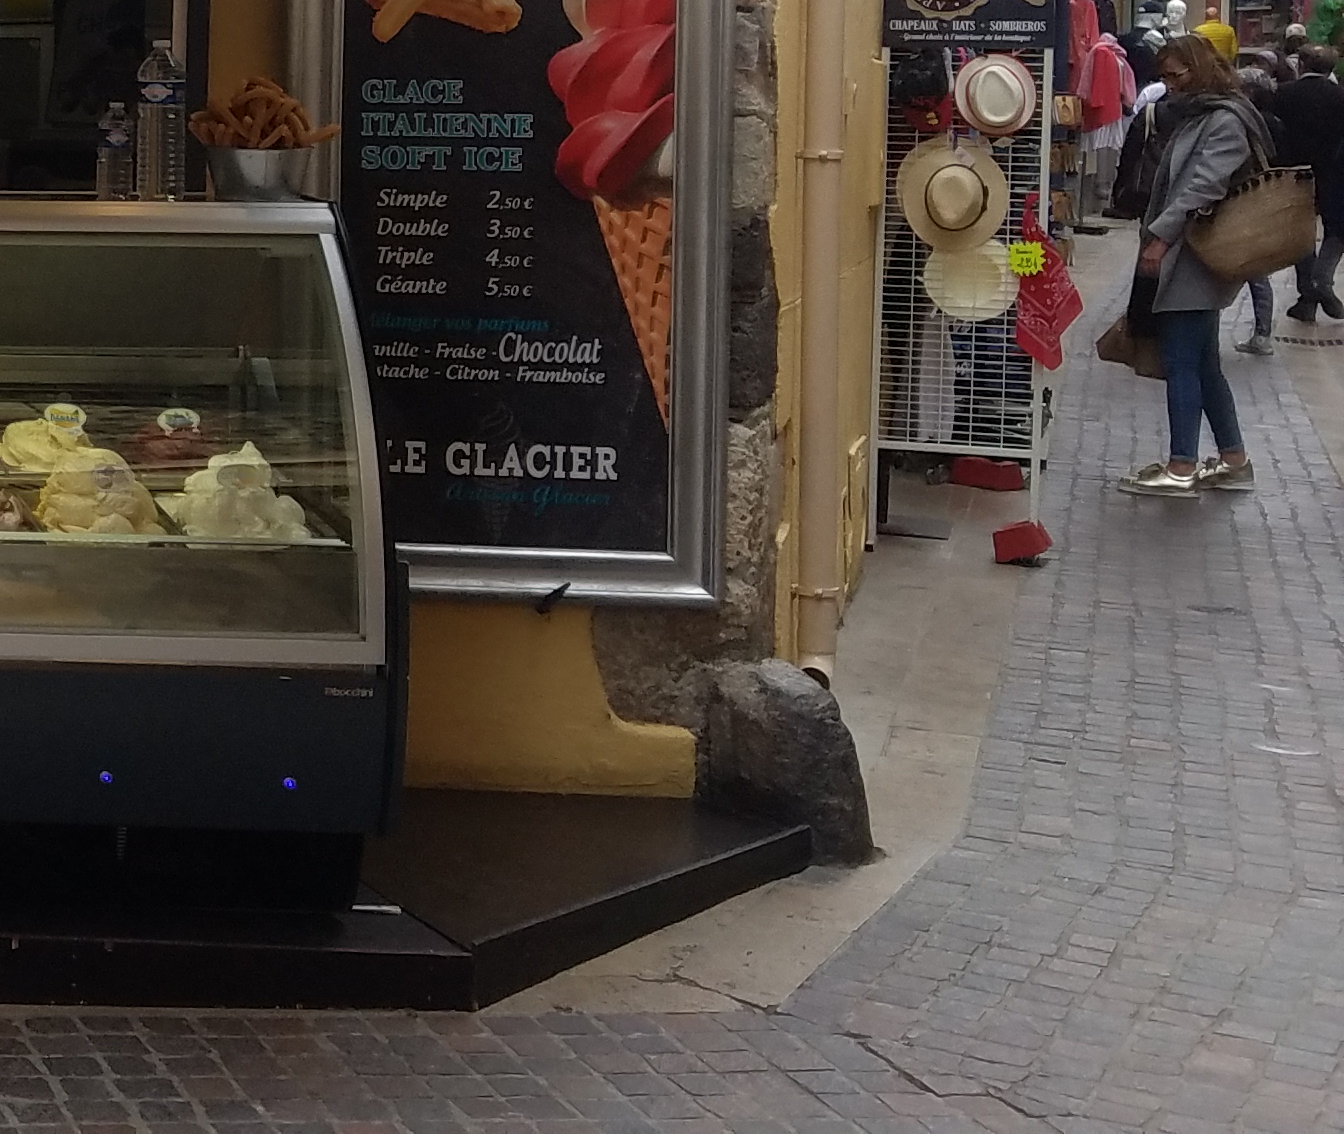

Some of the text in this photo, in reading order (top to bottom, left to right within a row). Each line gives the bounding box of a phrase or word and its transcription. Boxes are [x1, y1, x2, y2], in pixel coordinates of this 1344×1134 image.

[889, 19, 1046, 32] CHAPEAUX HATS SOMBREROS
[360, 78, 463, 105] GLACE
[360, 112, 533, 139] ITALIENNE
[360, 145, 523, 172] SOFT ICE
[376, 188, 448, 211] Simple
[376, 217, 449, 238] Double
[376, 247, 434, 269] Triple
[376, 275, 448, 296] Géante
[435, 342, 487, 359] Fraise
[498, 332, 602, 365] Chocolat
[445, 364, 500, 381] Citron
[516, 366, 606, 384] Framboise
[386, 439, 619, 481] LE GLACIER
